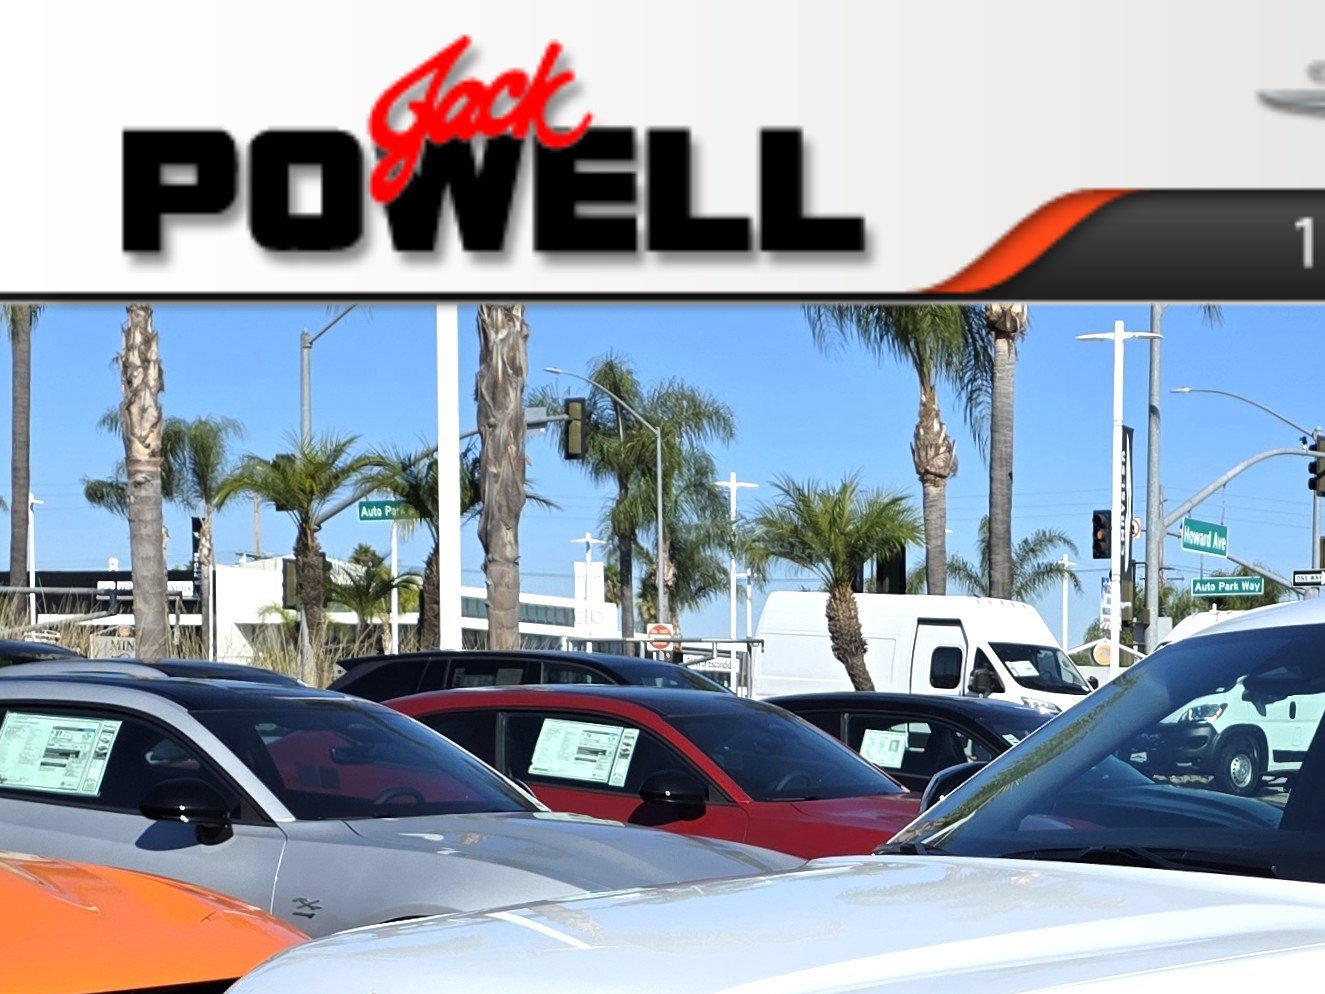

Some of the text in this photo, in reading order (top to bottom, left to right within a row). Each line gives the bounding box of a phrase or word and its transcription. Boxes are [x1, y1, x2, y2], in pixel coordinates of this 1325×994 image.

[361, 505, 383, 517] Auto
[1183, 525, 1227, 551] Howard Ave
[1194, 581, 1261, 593] Auto Park Way
